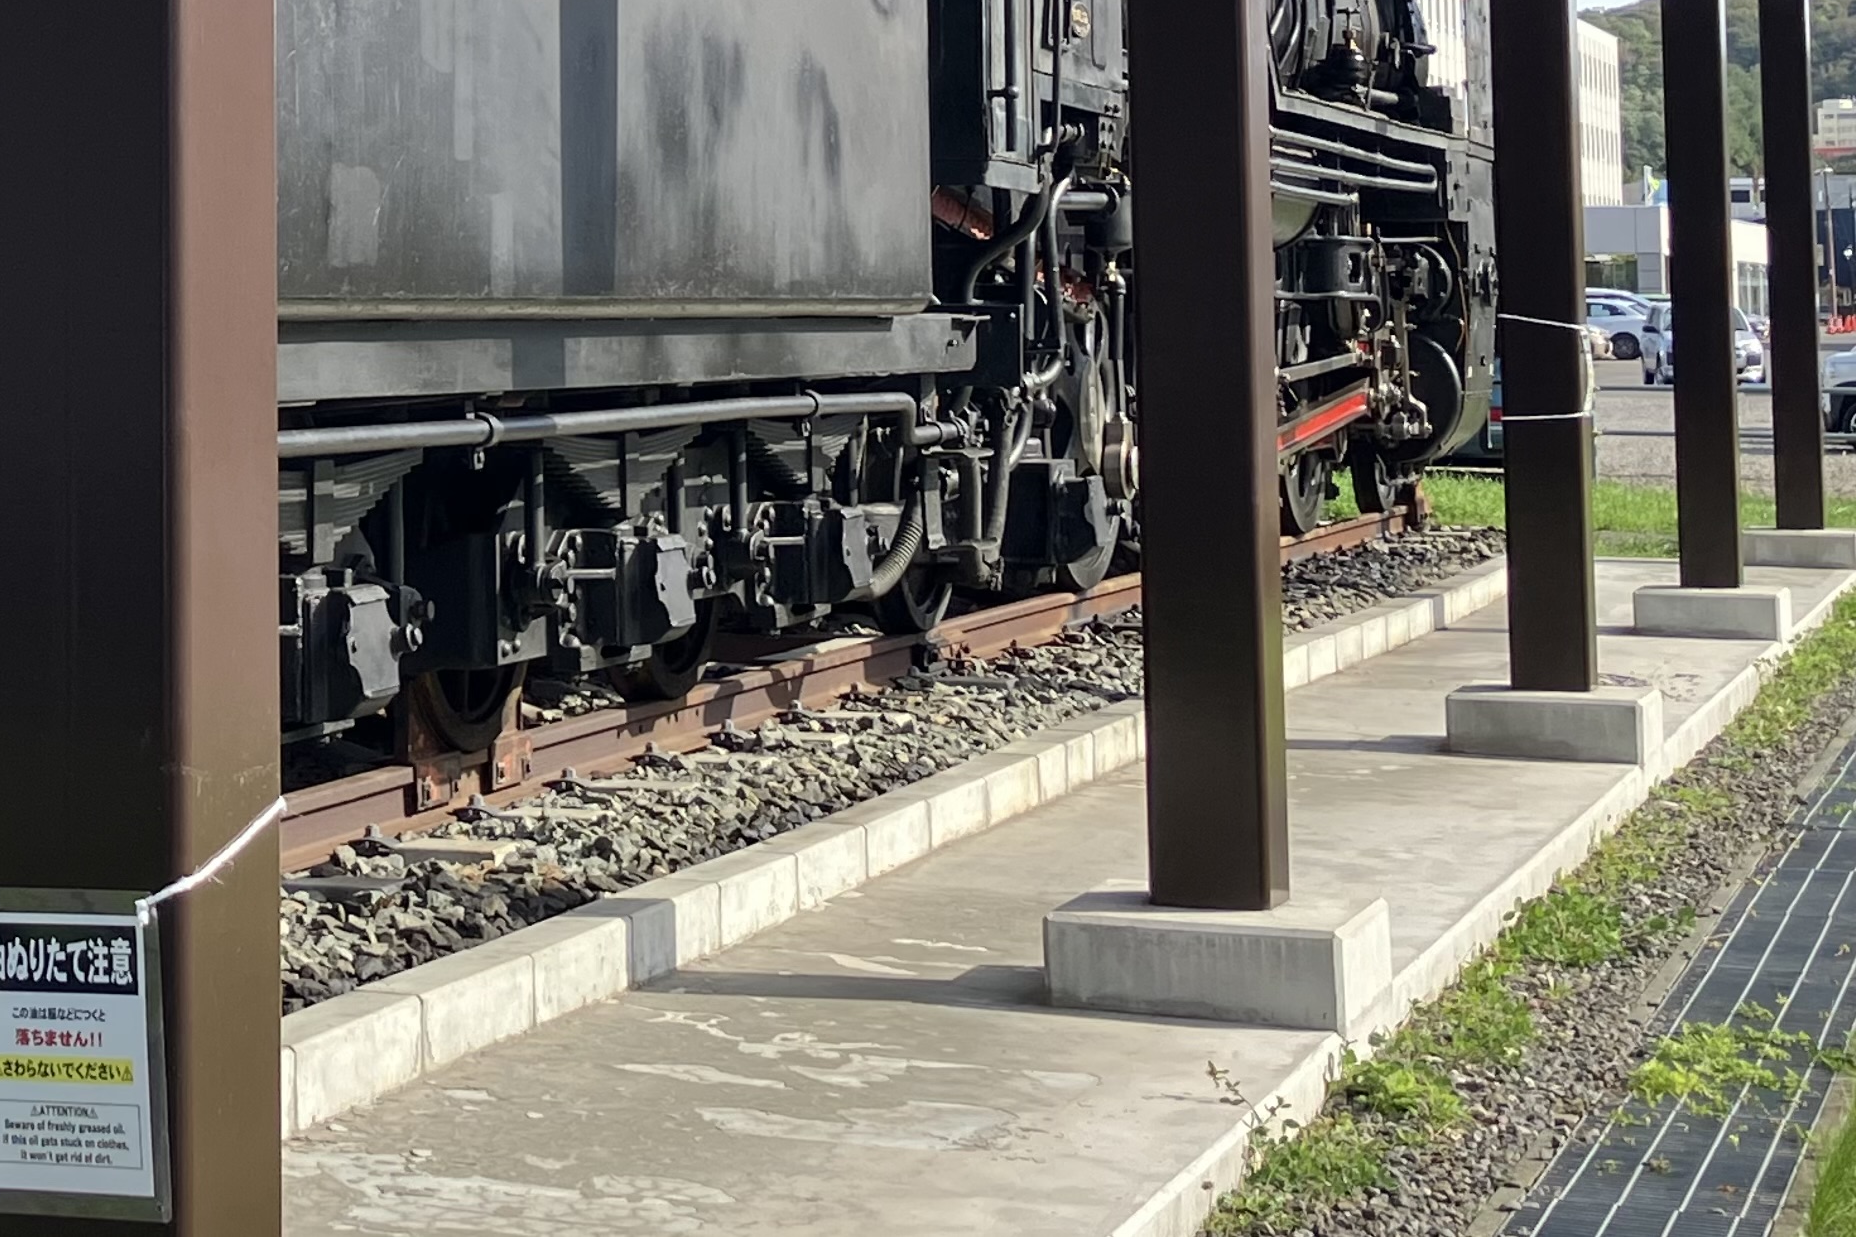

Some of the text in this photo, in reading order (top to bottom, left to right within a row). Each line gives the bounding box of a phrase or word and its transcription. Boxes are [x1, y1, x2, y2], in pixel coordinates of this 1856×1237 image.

[3, 1058, 121, 1081] さわらないでください
[39, 1105, 89, 1117] ATTENTION
[4, 1118, 35, 1131] Beware
